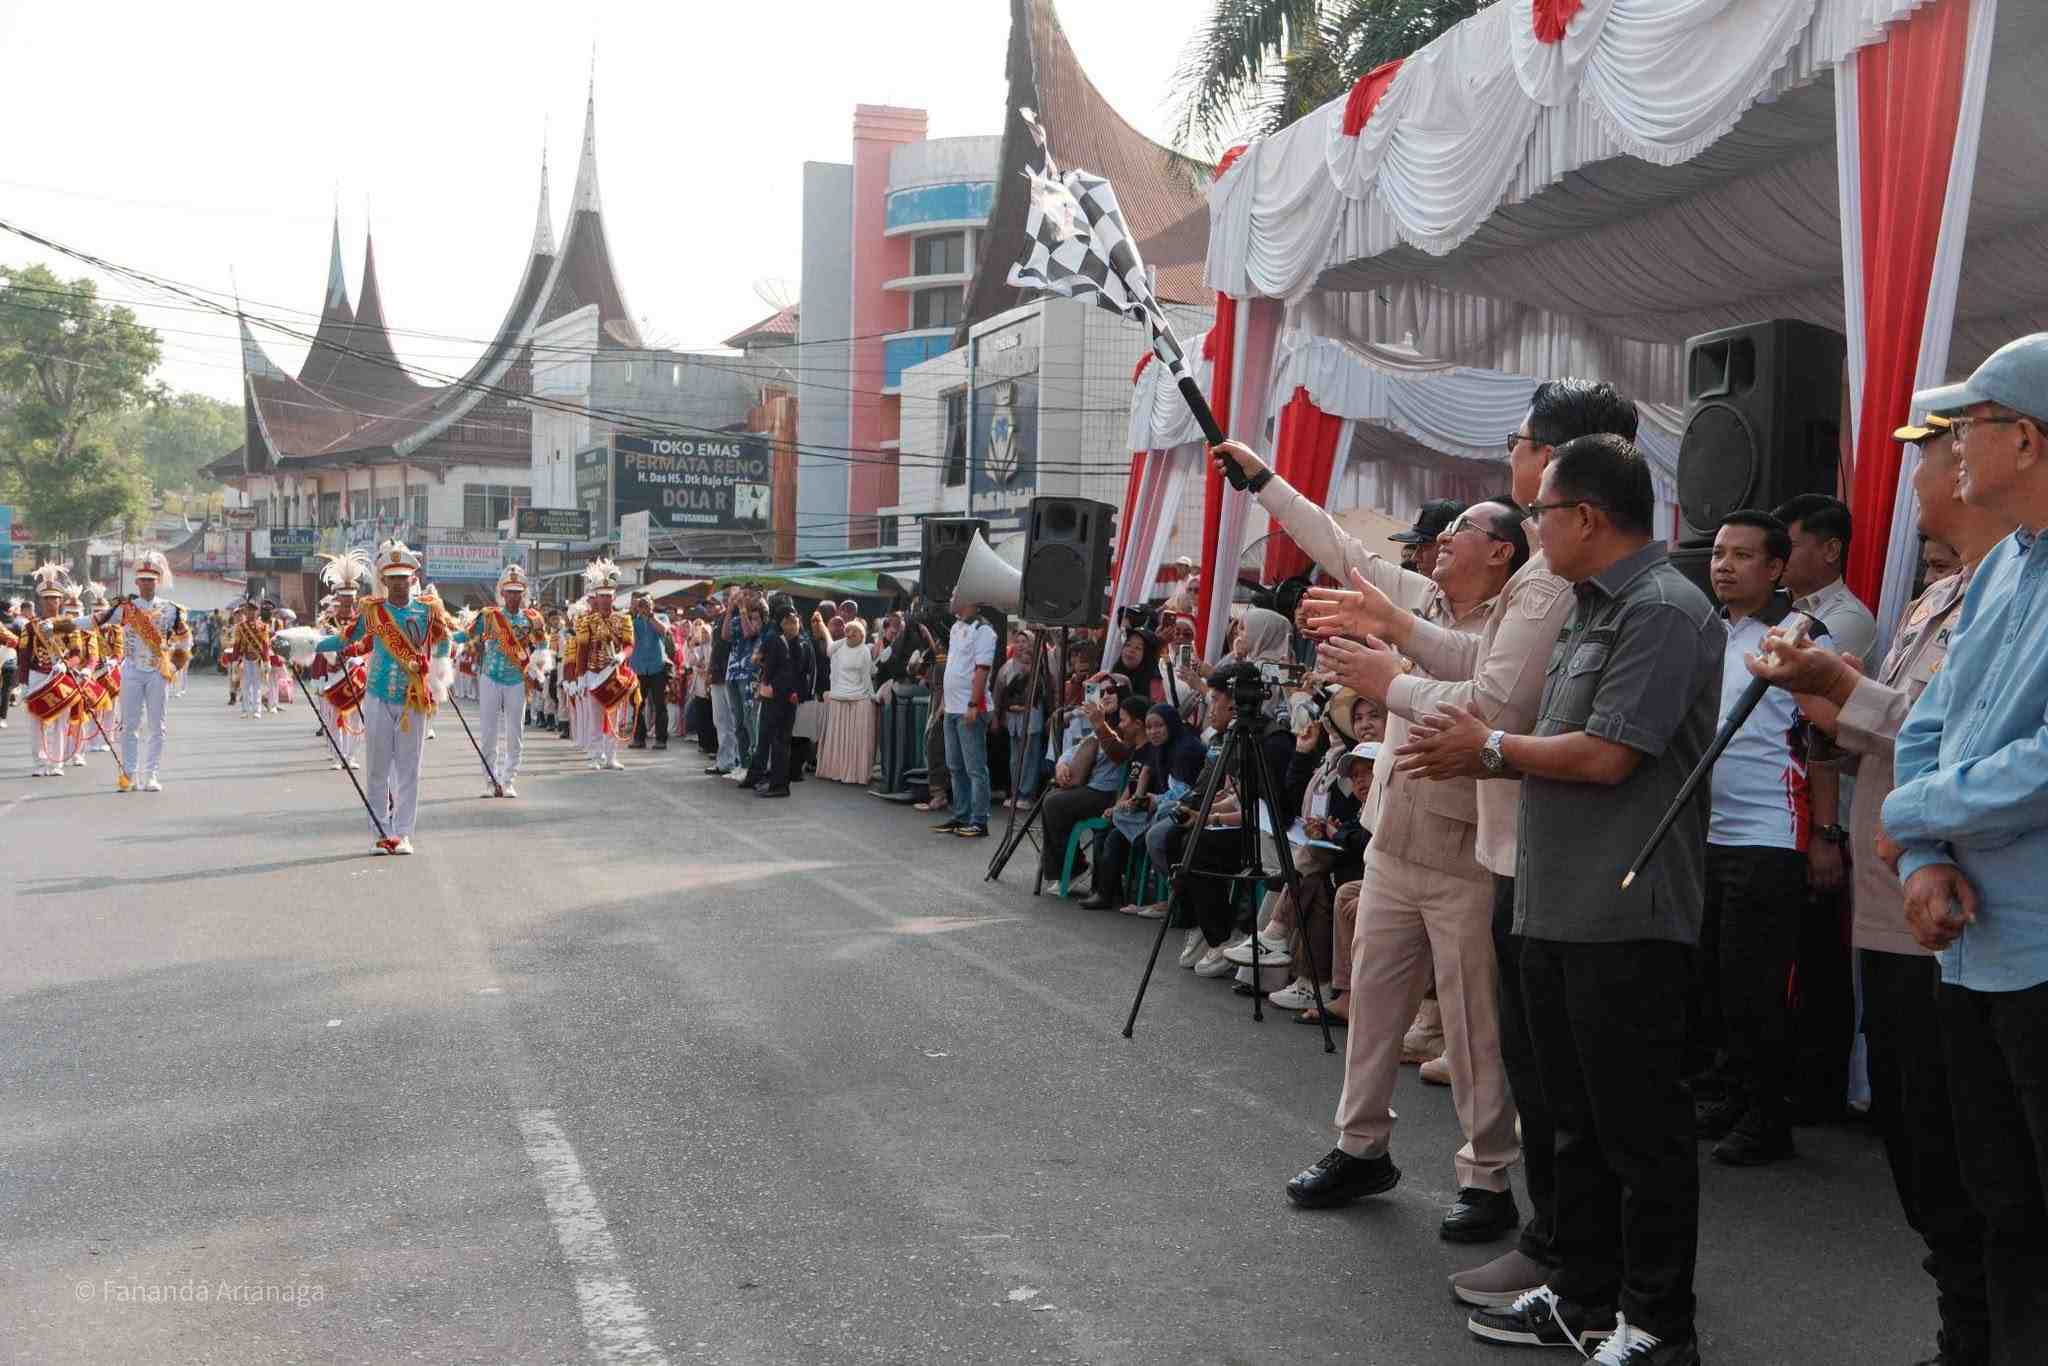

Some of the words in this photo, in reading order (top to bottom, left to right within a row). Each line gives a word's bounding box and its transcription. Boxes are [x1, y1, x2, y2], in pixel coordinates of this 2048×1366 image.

[650, 440, 694, 455] TOKO
[698, 443, 740, 457] EMAS
[624, 454, 709, 474] PERMATA
[713, 459, 764, 475] RENO
[638, 473, 648, 482] H.
[702, 475, 722, 488] Rajo
